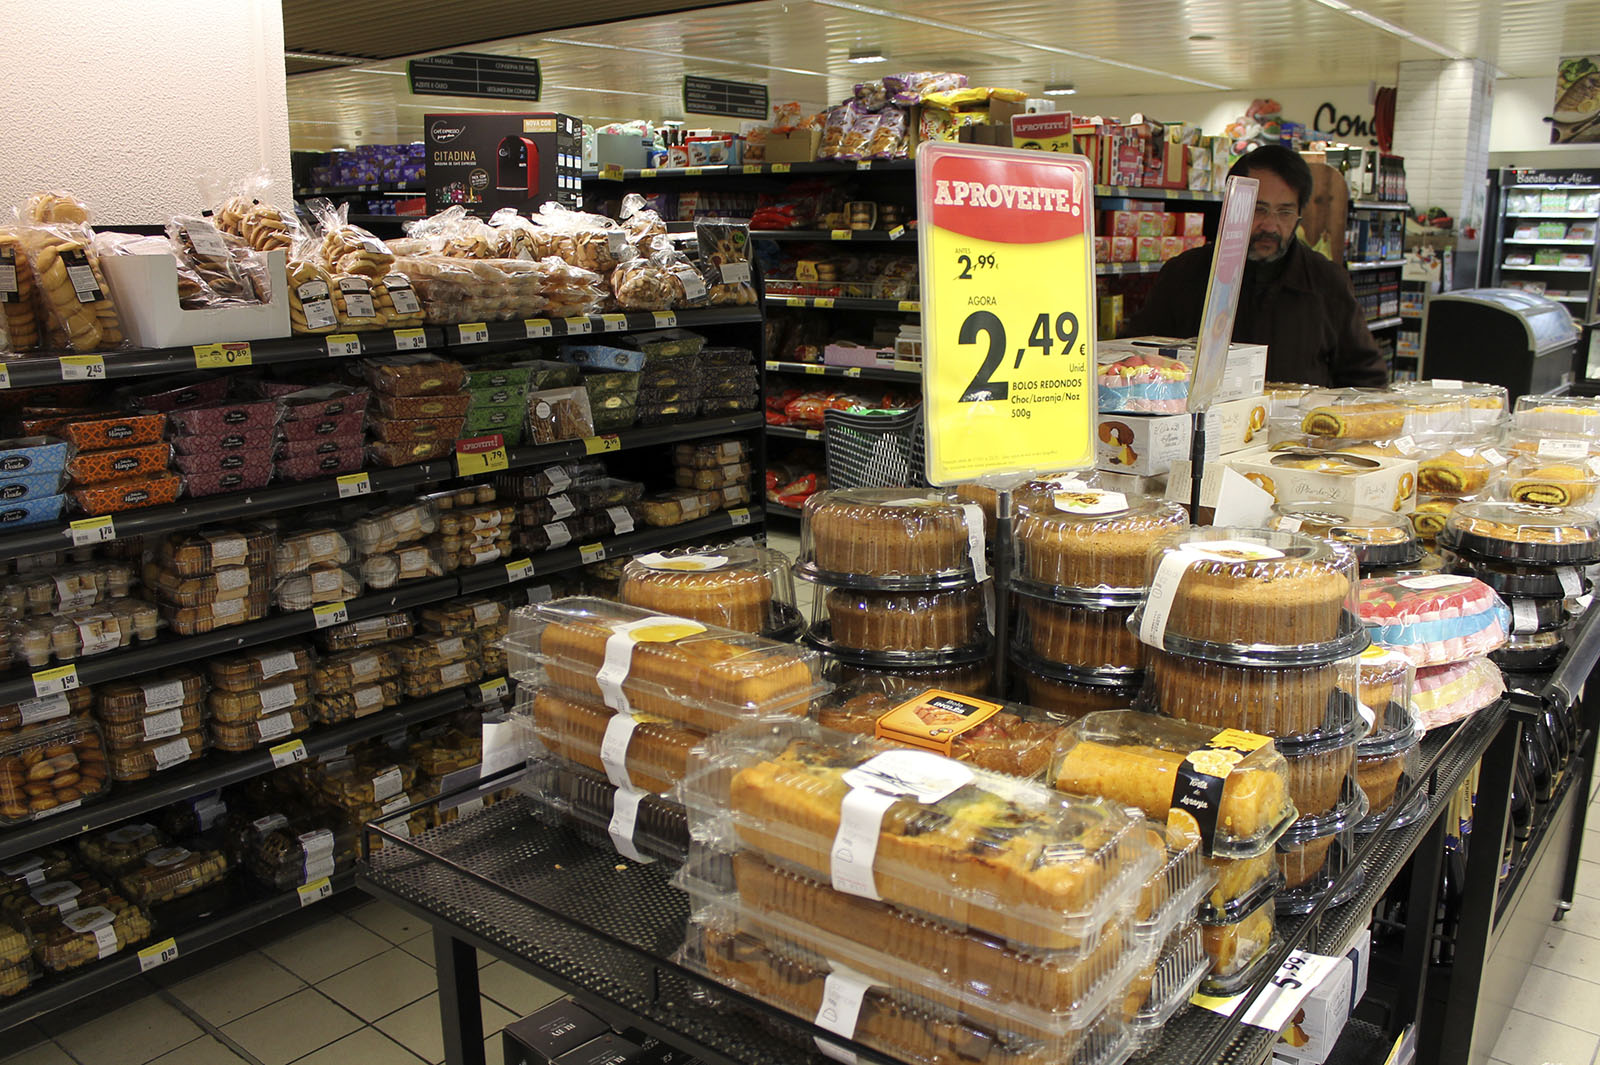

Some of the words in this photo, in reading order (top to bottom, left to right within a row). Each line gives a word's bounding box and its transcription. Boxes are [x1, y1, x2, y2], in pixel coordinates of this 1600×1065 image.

[434, 151, 477, 161] CITADINA
[934, 170, 1084, 217] APROVEITE!
[968, 296, 997, 306] AGORA
[1069, 362, 1086, 373] Unid.
[1012, 380, 1038, 391] BOLOS
[1040, 378, 1082, 390] REDONDOS
[1011, 393, 1080, 404] Choc/Laranja/Noz
[1011, 408, 1031, 419] 500g
[60, 675, 76, 689] 1.50
[946, 699, 964, 709] Bolo
[1188, 777, 1209, 790] Torta
[1180, 795, 1209, 809] Laranja
